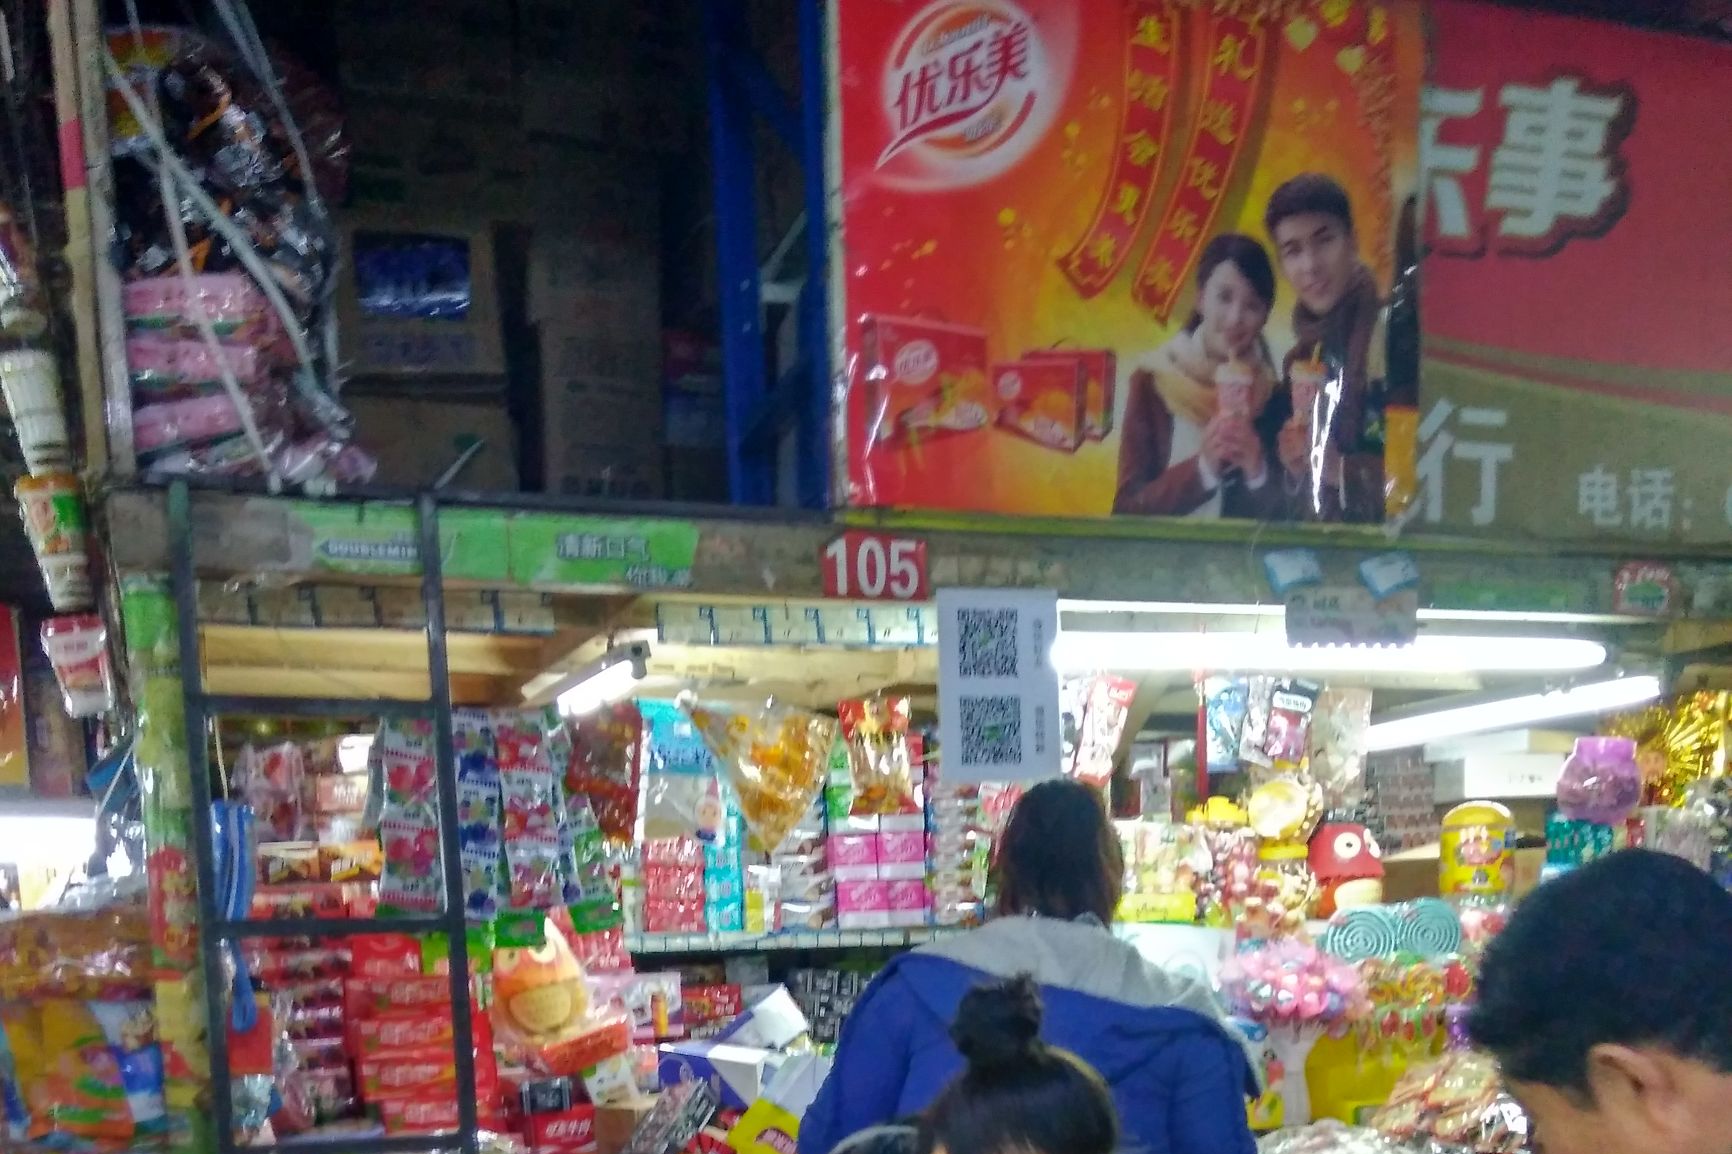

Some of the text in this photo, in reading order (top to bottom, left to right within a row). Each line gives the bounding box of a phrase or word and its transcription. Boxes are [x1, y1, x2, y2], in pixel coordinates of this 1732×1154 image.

[893, 20, 1029, 131] 优乐美
[1416, 397, 1514, 527] 行
[327, 539, 418, 559] DOUBLEMIN
[556, 533, 651, 561] 清新口气
[826, 536, 919, 598] 105
